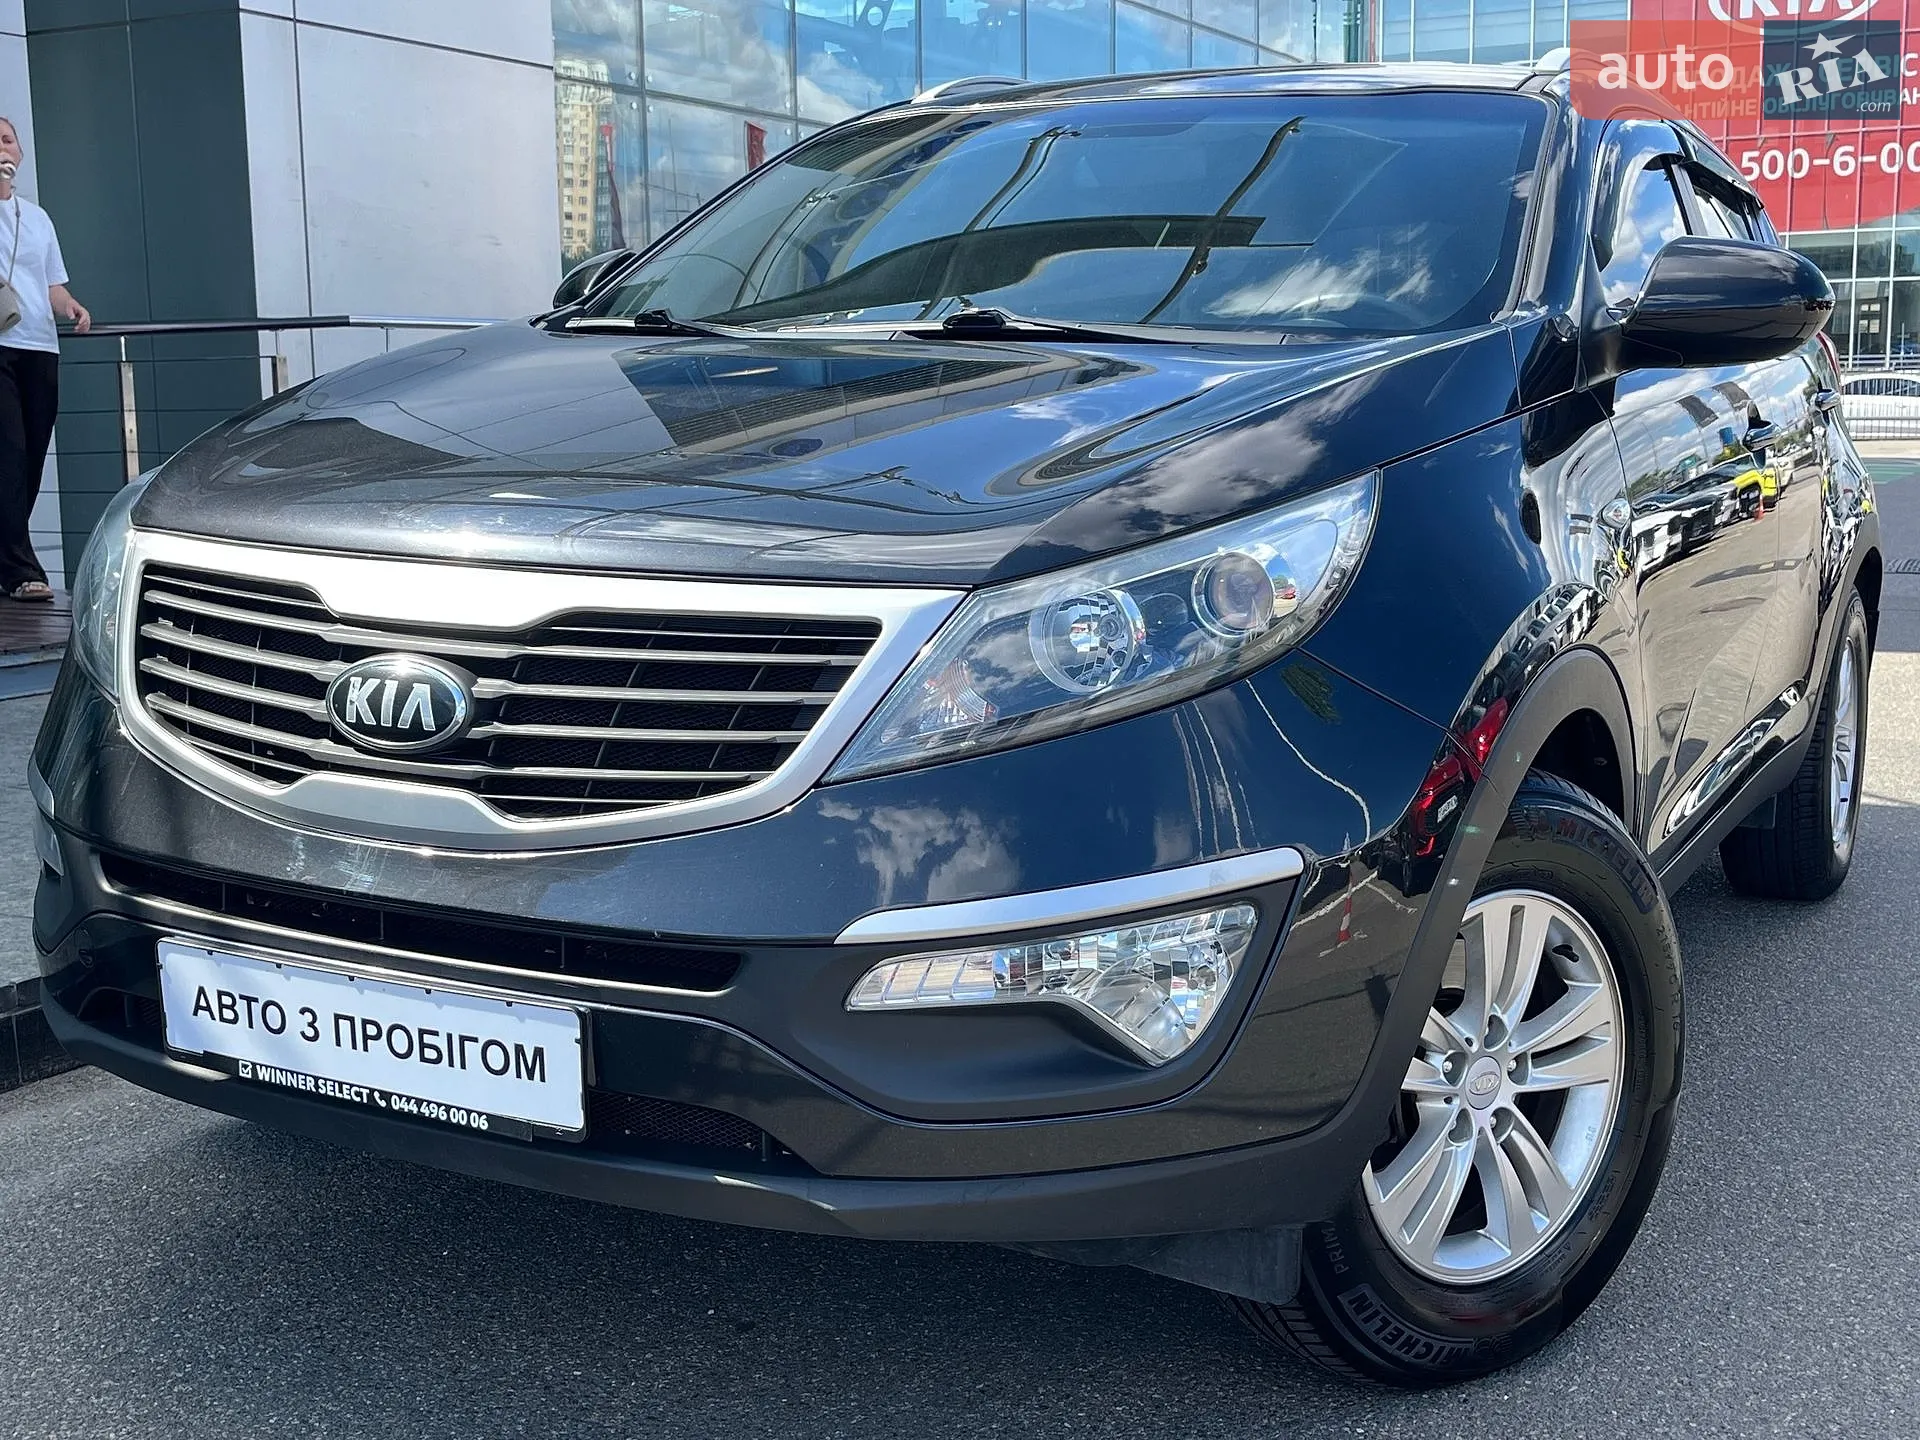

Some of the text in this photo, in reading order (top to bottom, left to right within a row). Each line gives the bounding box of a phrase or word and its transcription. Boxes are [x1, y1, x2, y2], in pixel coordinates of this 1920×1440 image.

[346, 676, 436, 731] KIA
[192, 985, 546, 1083] АВТО З ПРОБІГОМ
[255, 1064, 489, 1131] WINNER SELECT 044 496 00 06
[1348, 1291, 1472, 1366] MICHELIN
